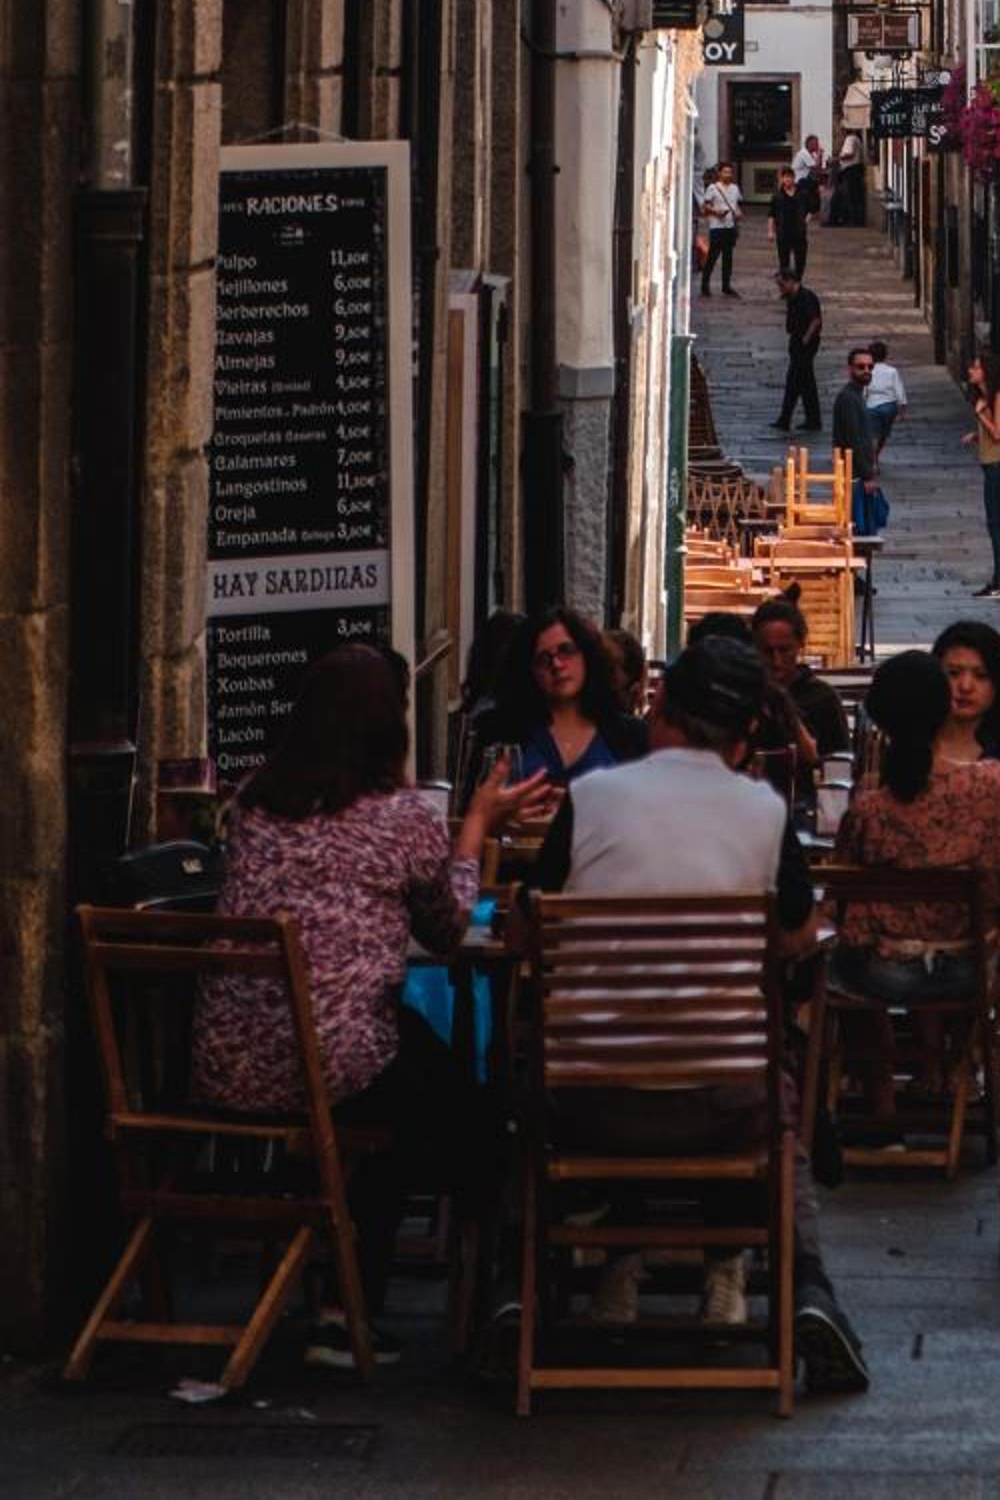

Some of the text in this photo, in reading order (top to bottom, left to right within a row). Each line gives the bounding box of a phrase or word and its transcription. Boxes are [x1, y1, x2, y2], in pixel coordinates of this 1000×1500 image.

[246, 193, 338, 217] RACIONES
[215, 354, 276, 373] Almejas
[215, 454, 297, 471] Calamares
[215, 476, 308, 499] Langostinos
[215, 504, 257, 525] Oreja
[216, 526, 297, 548] Empanada
[213, 572, 258, 600] HAY
[217, 625, 271, 643] Tortilla
[217, 649, 308, 670] Boquerones
[217, 676, 275, 693] Xoubas
[217, 725, 265, 743] Lacón
[217, 752, 267, 771] Queso
